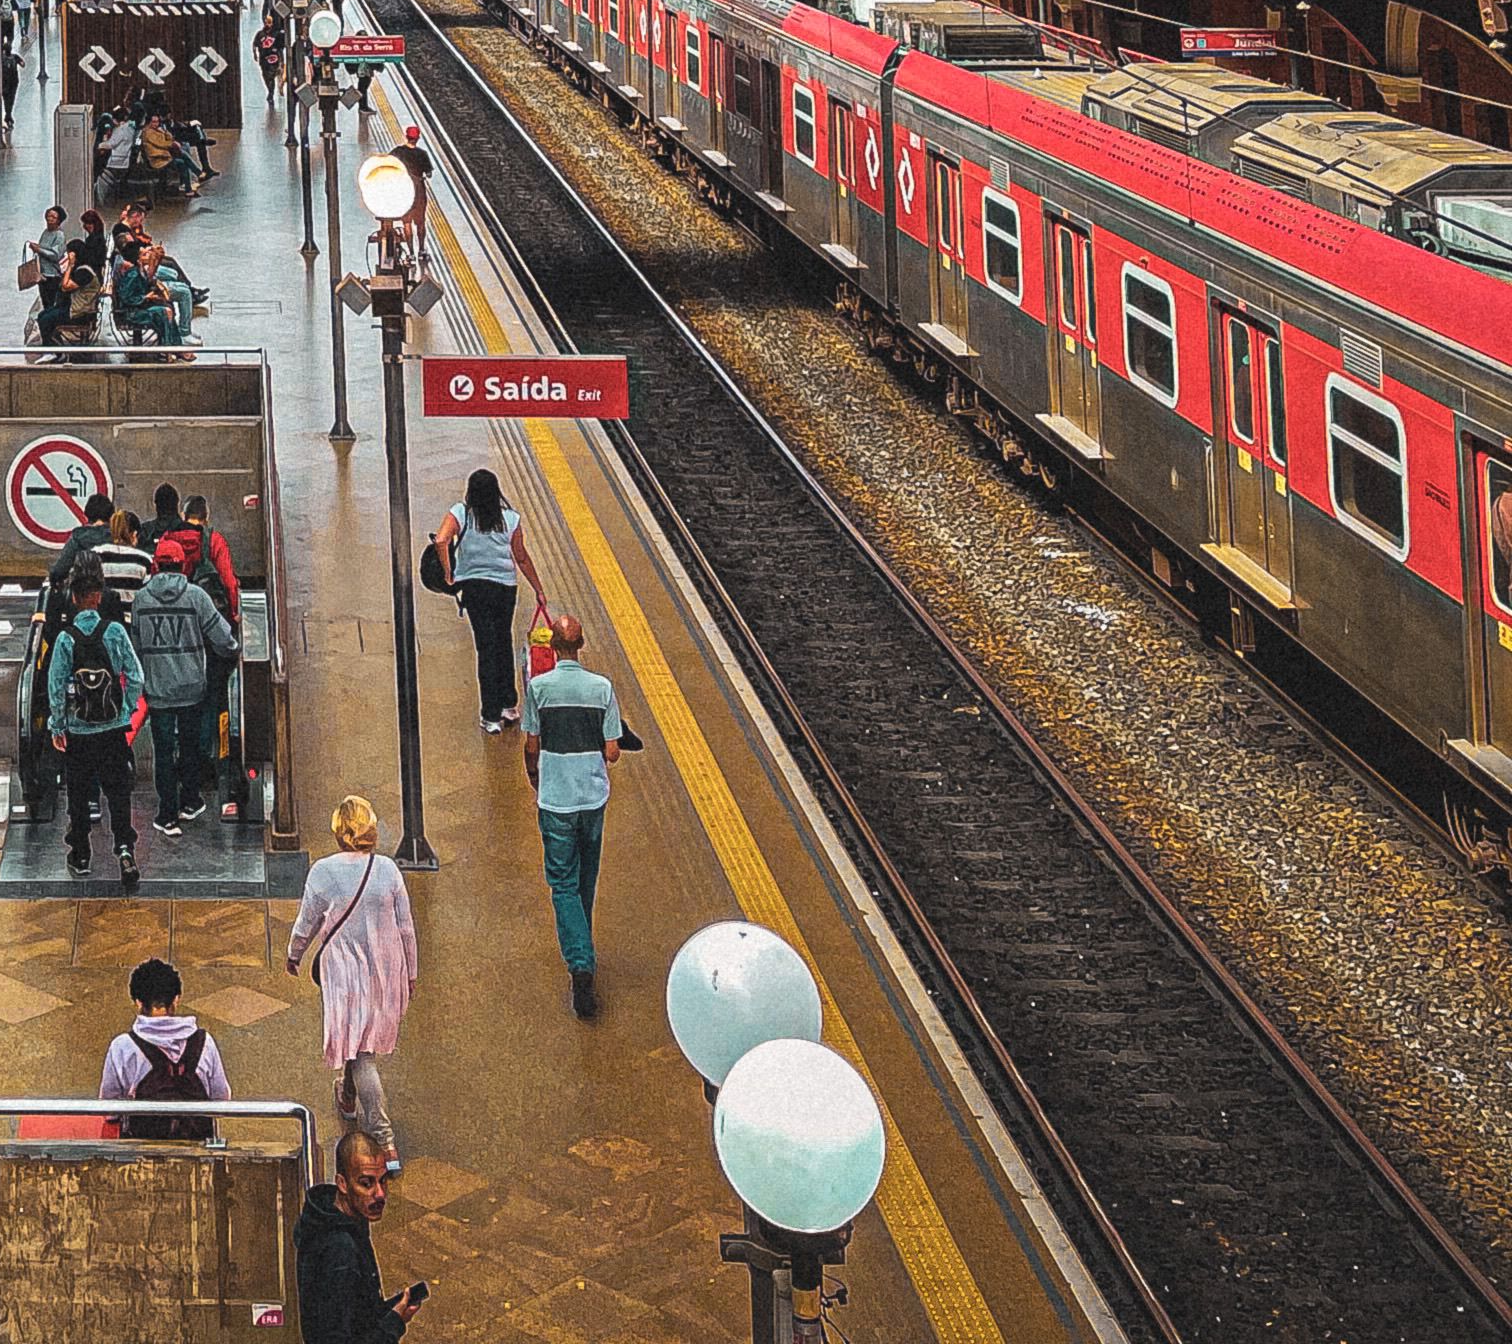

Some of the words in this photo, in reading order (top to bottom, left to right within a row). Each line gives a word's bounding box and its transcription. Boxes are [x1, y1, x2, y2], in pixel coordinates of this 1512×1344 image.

[484, 375, 567, 401] Saída
[577, 389, 602, 402] Exit
[148, 615, 186, 646] XV
